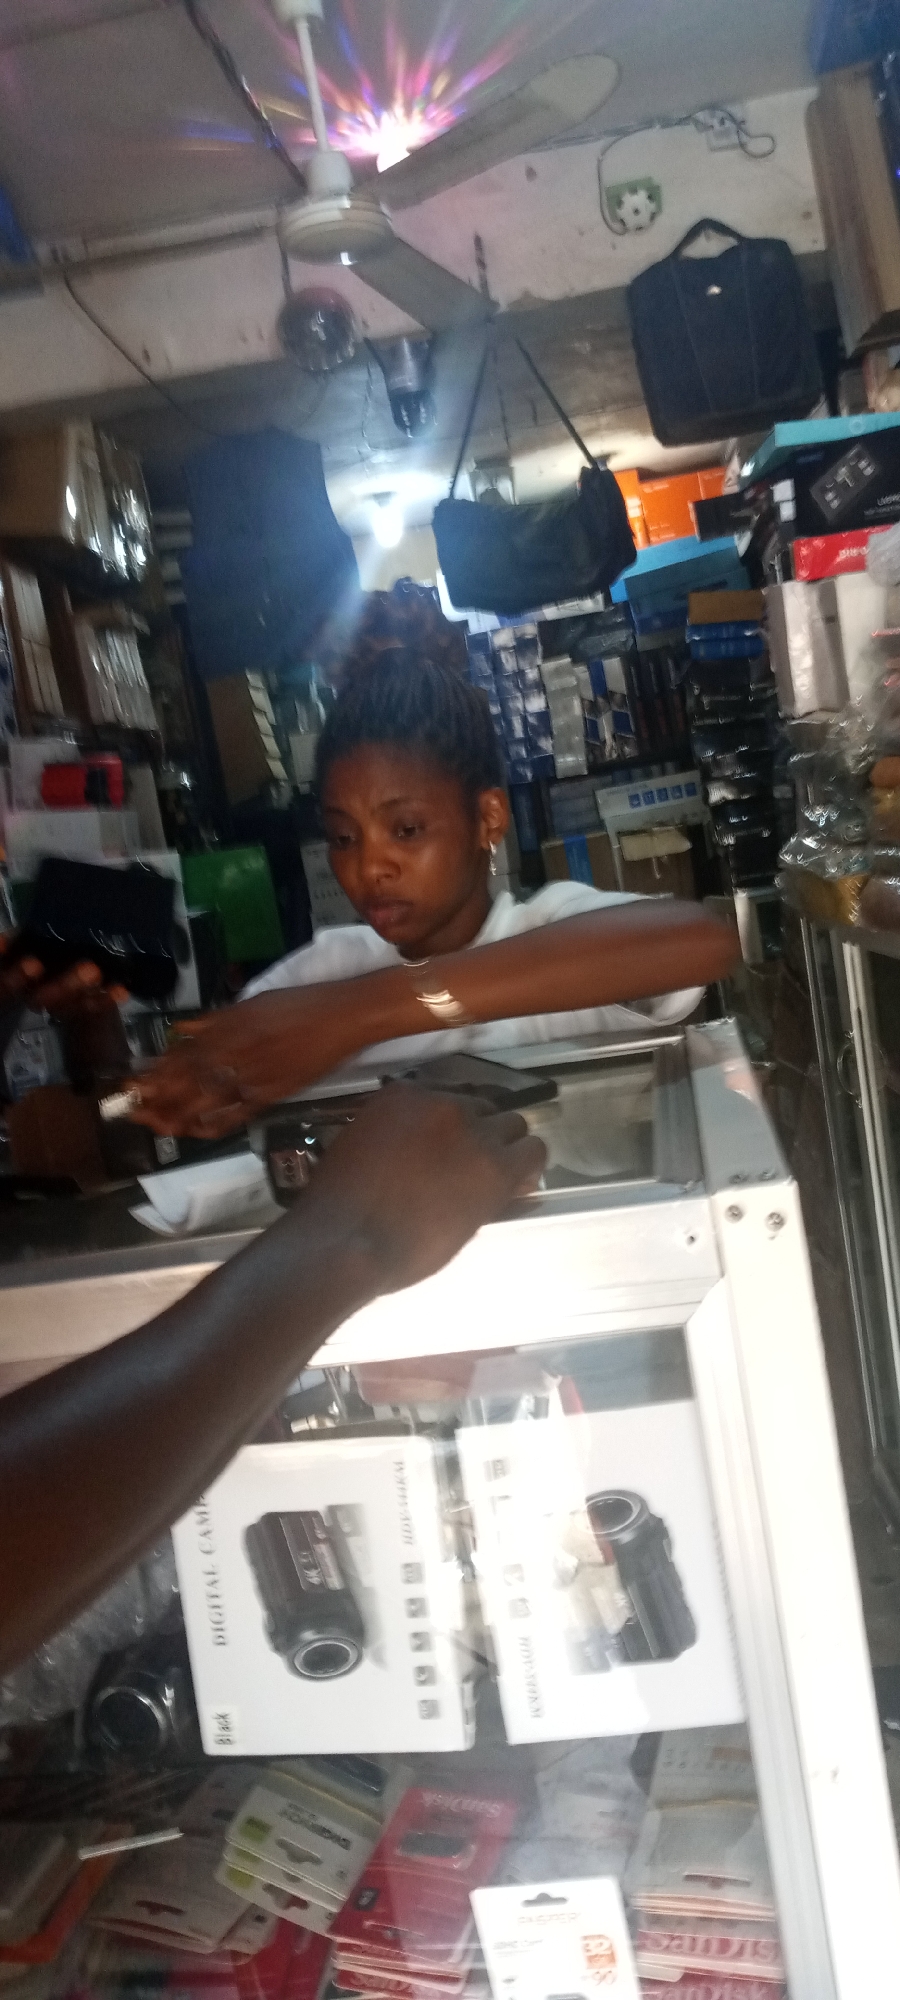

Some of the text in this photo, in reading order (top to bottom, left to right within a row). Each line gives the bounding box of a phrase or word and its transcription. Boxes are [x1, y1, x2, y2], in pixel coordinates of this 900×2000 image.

[204, 1563, 229, 1647] DIGITAL
[211, 1712, 235, 1747] Black
[582, 1939, 612, 1957] 32
